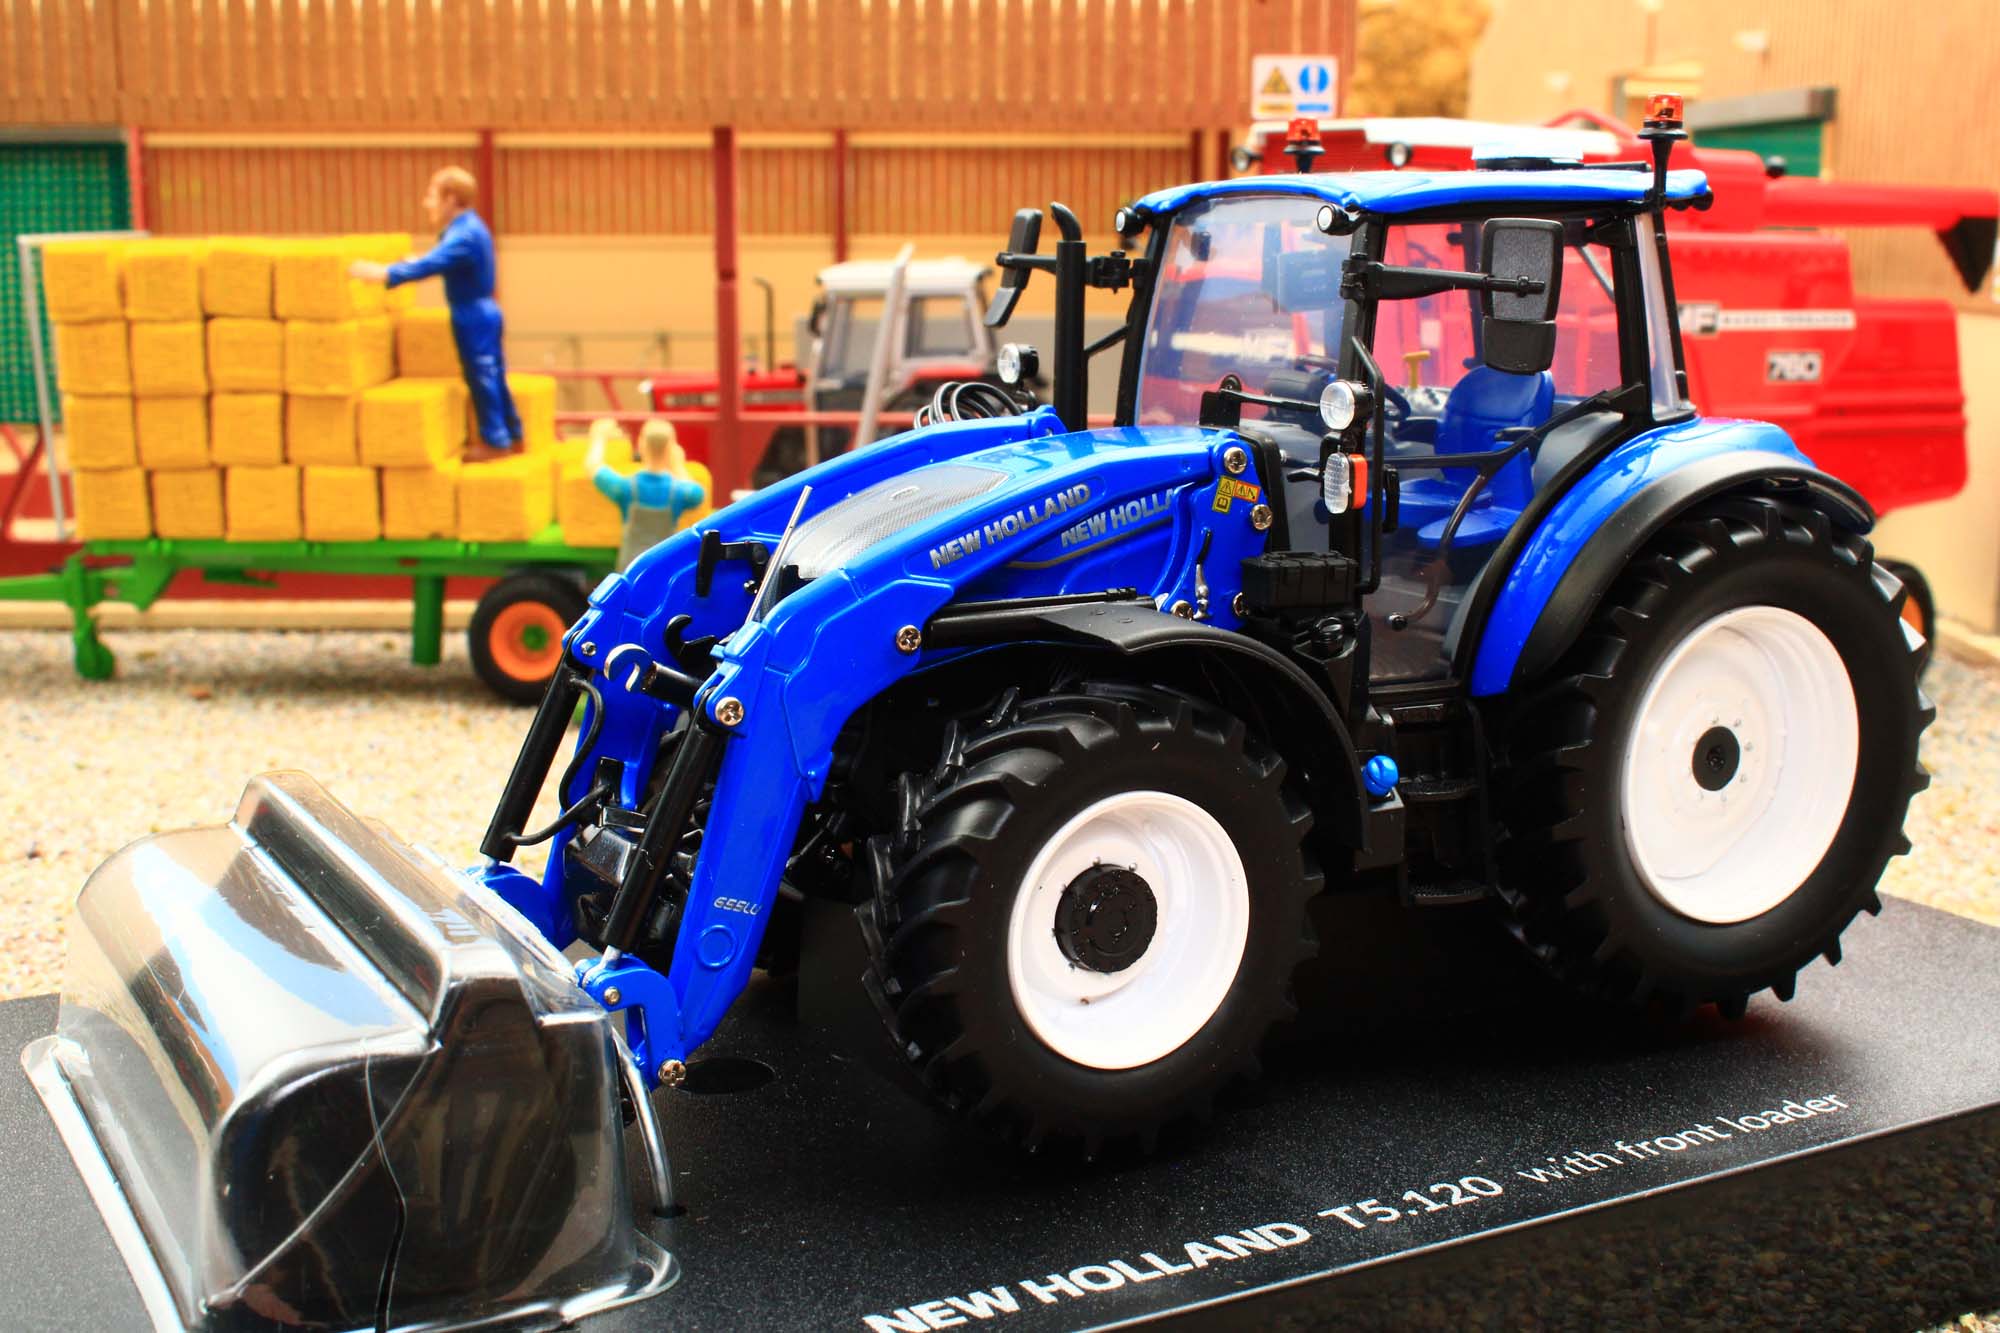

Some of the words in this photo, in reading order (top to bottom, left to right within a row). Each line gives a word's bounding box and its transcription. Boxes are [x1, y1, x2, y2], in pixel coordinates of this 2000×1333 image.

[929, 529, 982, 570] NEW
[984, 483, 1092, 545] HOLLAND
[1060, 513, 1107, 548] NEW
[862, 1285, 1021, 1333] NEW
[1020, 1221, 1313, 1304] HOLLAND
[1317, 1175, 1505, 1230] T5.120
[1516, 1149, 1624, 1184] with
[1614, 1123, 1732, 1160] front
[1720, 1092, 1849, 1132] loader
